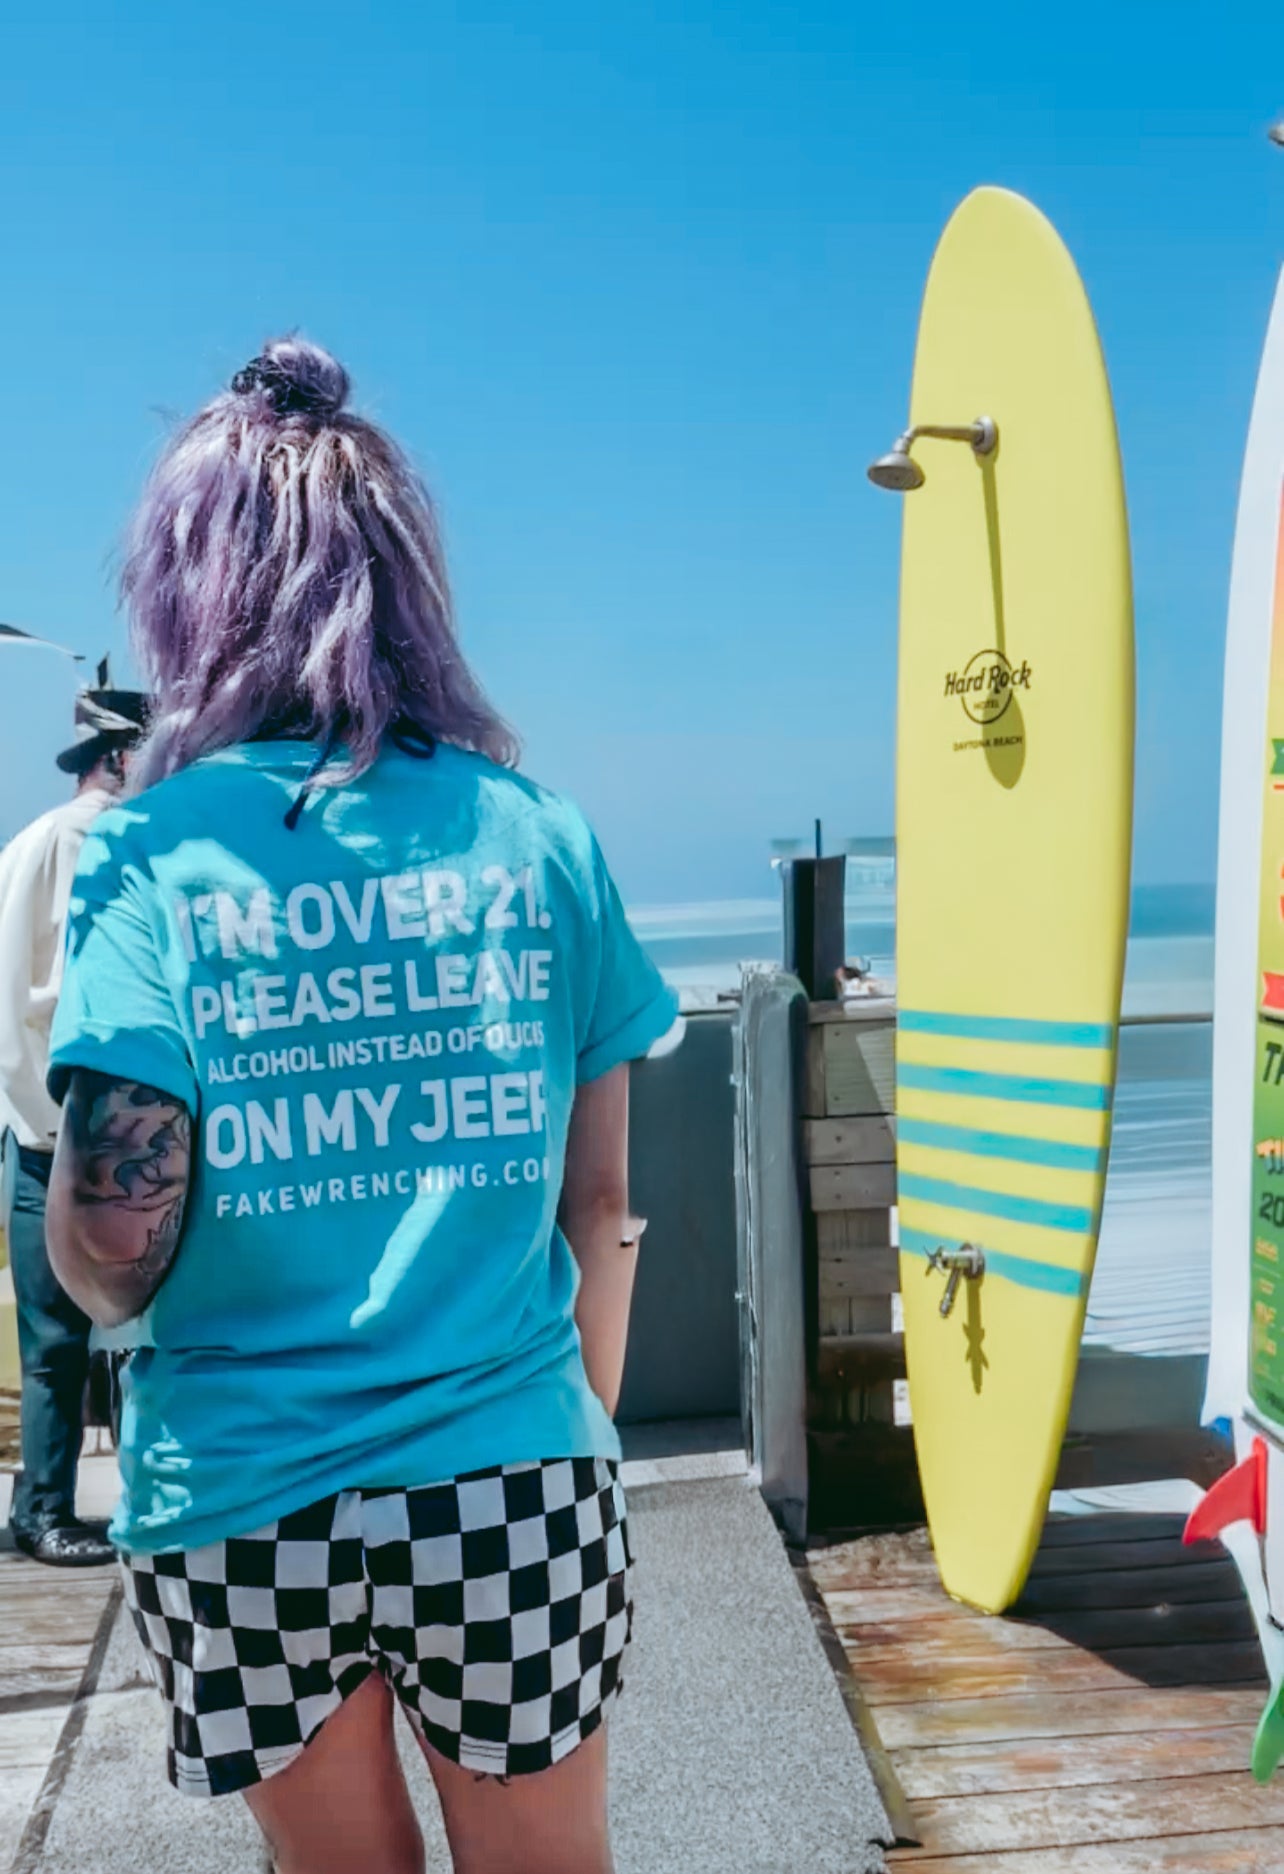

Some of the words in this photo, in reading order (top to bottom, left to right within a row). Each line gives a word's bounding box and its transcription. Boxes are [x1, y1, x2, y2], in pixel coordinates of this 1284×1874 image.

[944, 667, 986, 697] Hard
[988, 660, 1032, 694] Rock
[953, 739, 991, 752] DAYTONA
[993, 736, 1023, 747] BEACH
[174, 887, 278, 962] I'M
[286, 868, 475, 951] OVER
[481, 865, 552, 929] 21.
[191, 962, 396, 1040] PLEASE
[404, 949, 553, 1012] LEAVE
[207, 1045, 325, 1085] ALCOHOL
[329, 1029, 442, 1067] INSTEAD
[448, 1025, 482, 1053] OF
[205, 1098, 293, 1170] ON
[303, 1083, 402, 1156] MY
